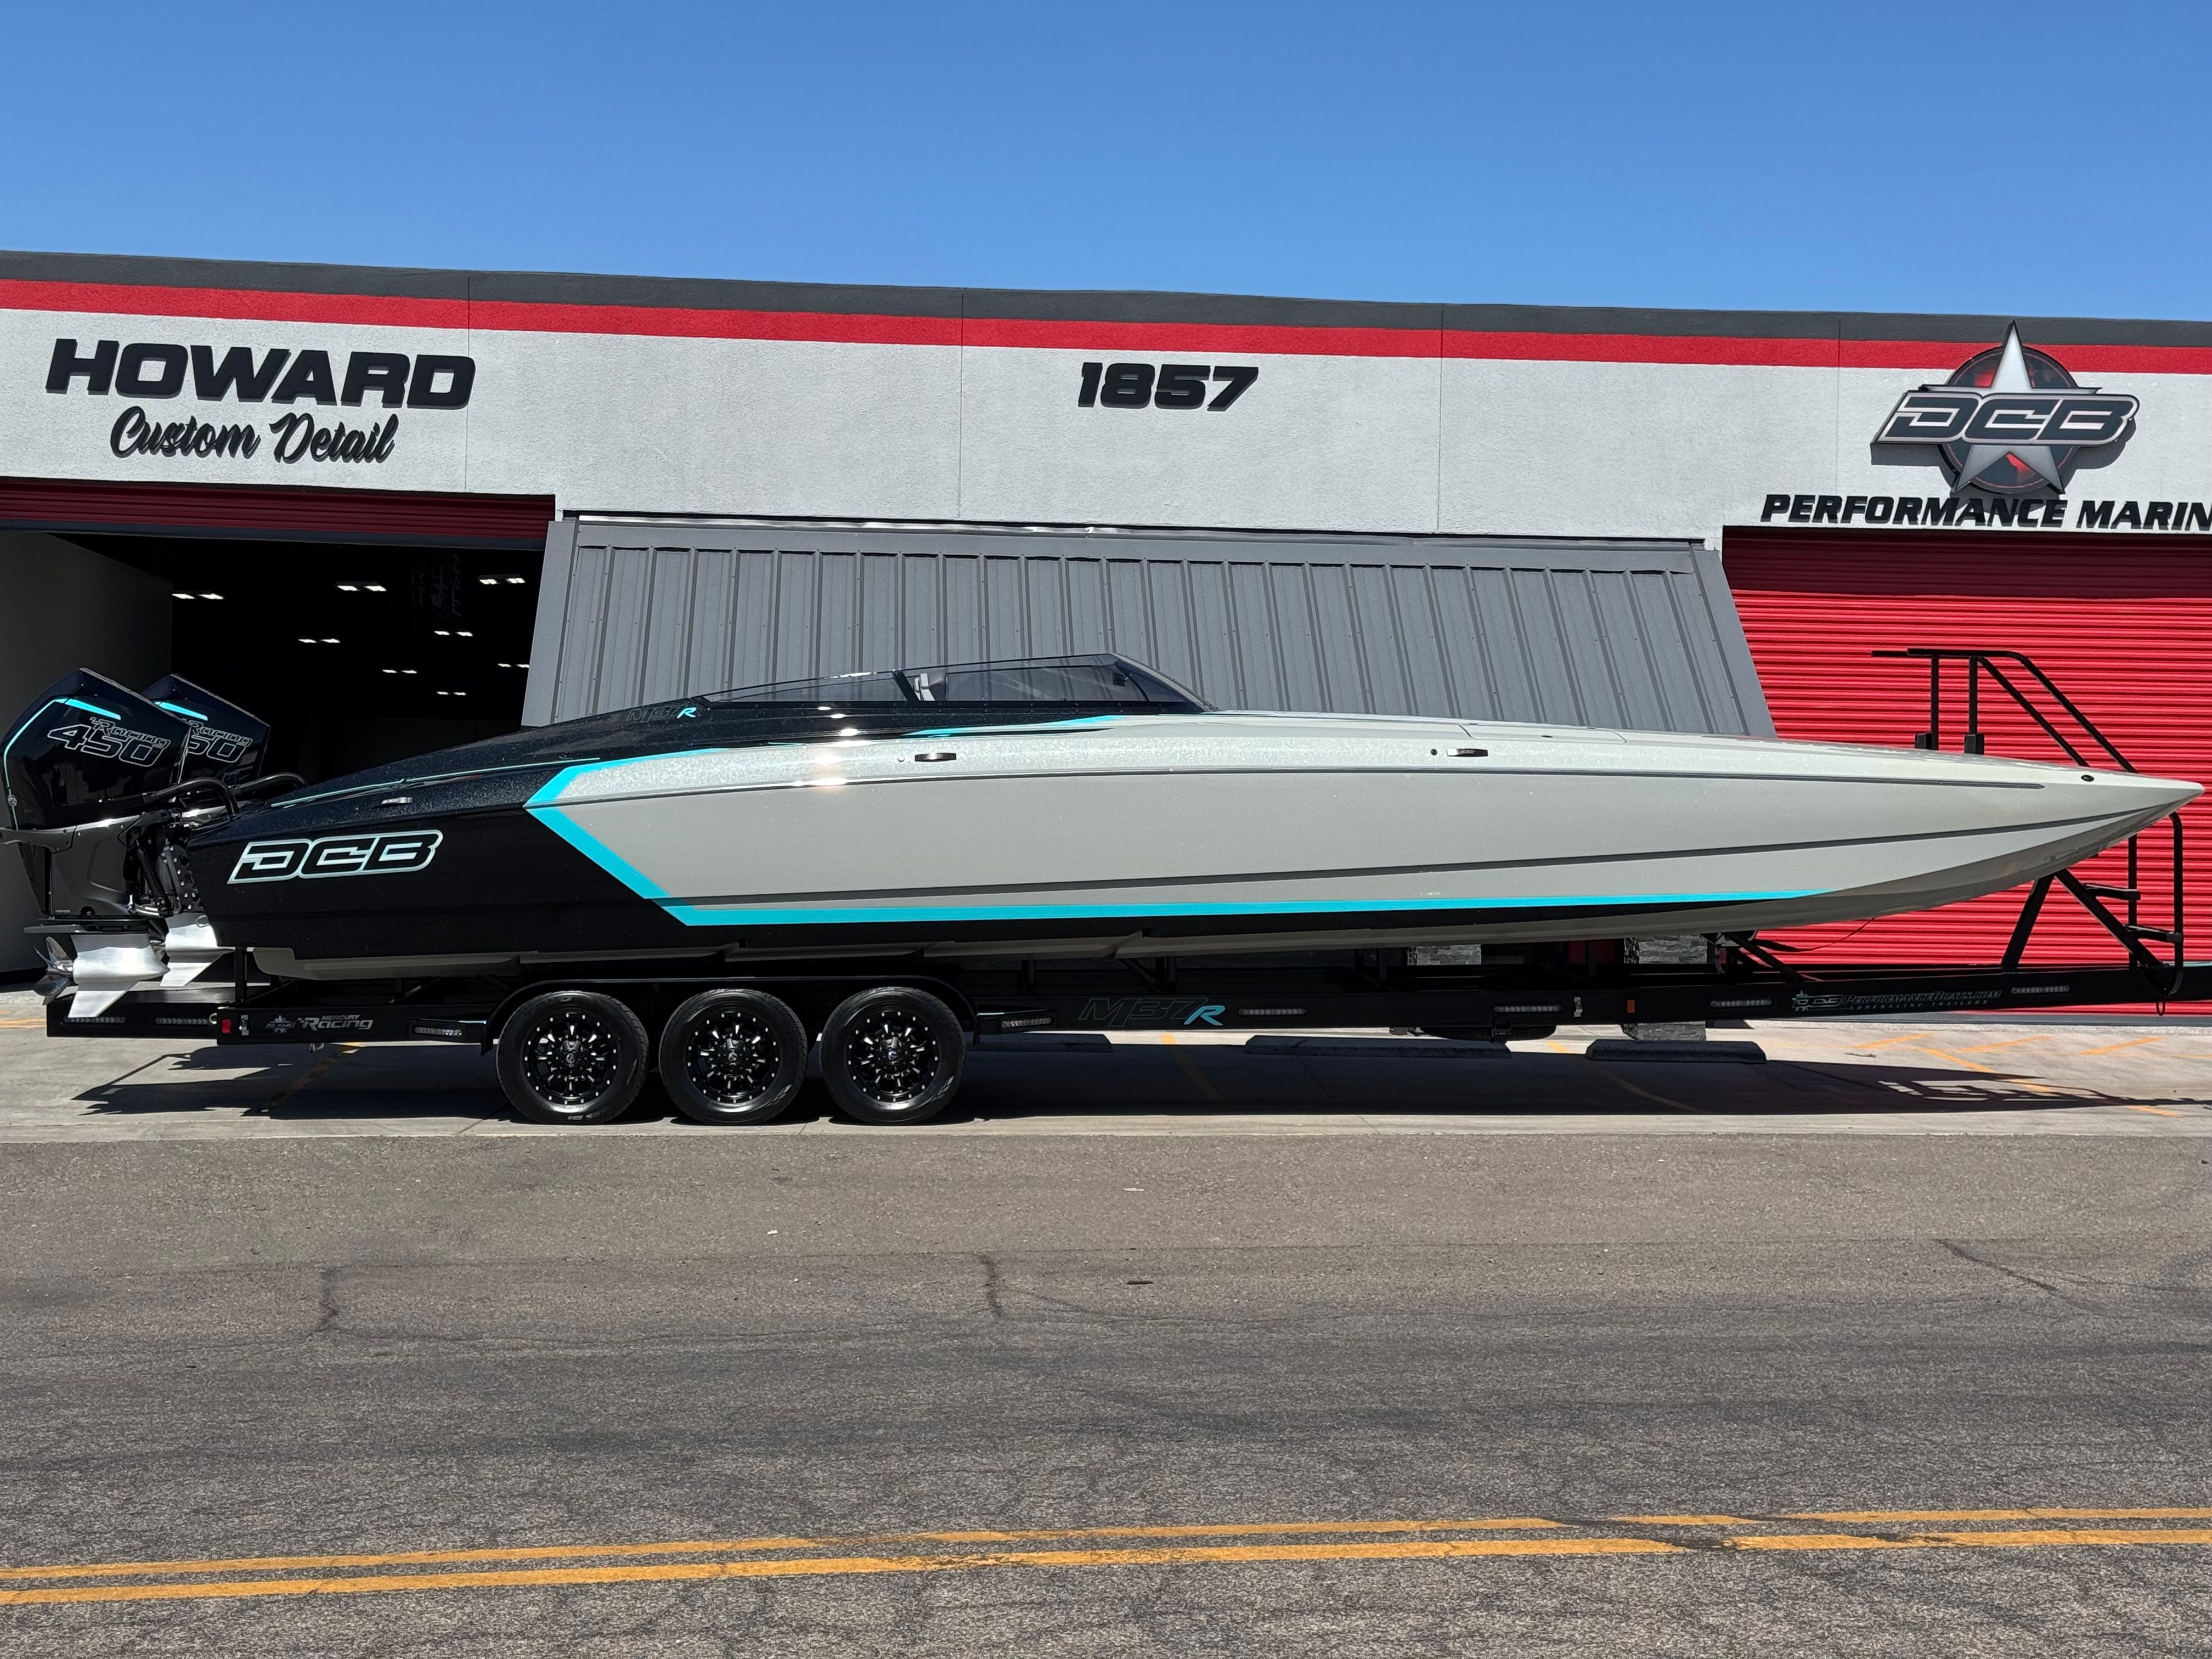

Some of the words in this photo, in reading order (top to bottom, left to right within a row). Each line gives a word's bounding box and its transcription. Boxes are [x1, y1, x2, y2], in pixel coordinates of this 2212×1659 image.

[46, 338, 476, 410] HOWARD
[1077, 362, 1259, 411] 1857
[110, 406, 261, 460] Custom
[270, 412, 399, 464] Detail
[1871, 391, 2140, 446] DCB
[1760, 493, 2068, 529] PERFORMANCE
[47, 724, 166, 767] 450
[226, 829, 444, 885] DCB
[298, 1017, 374, 1031] Racing
